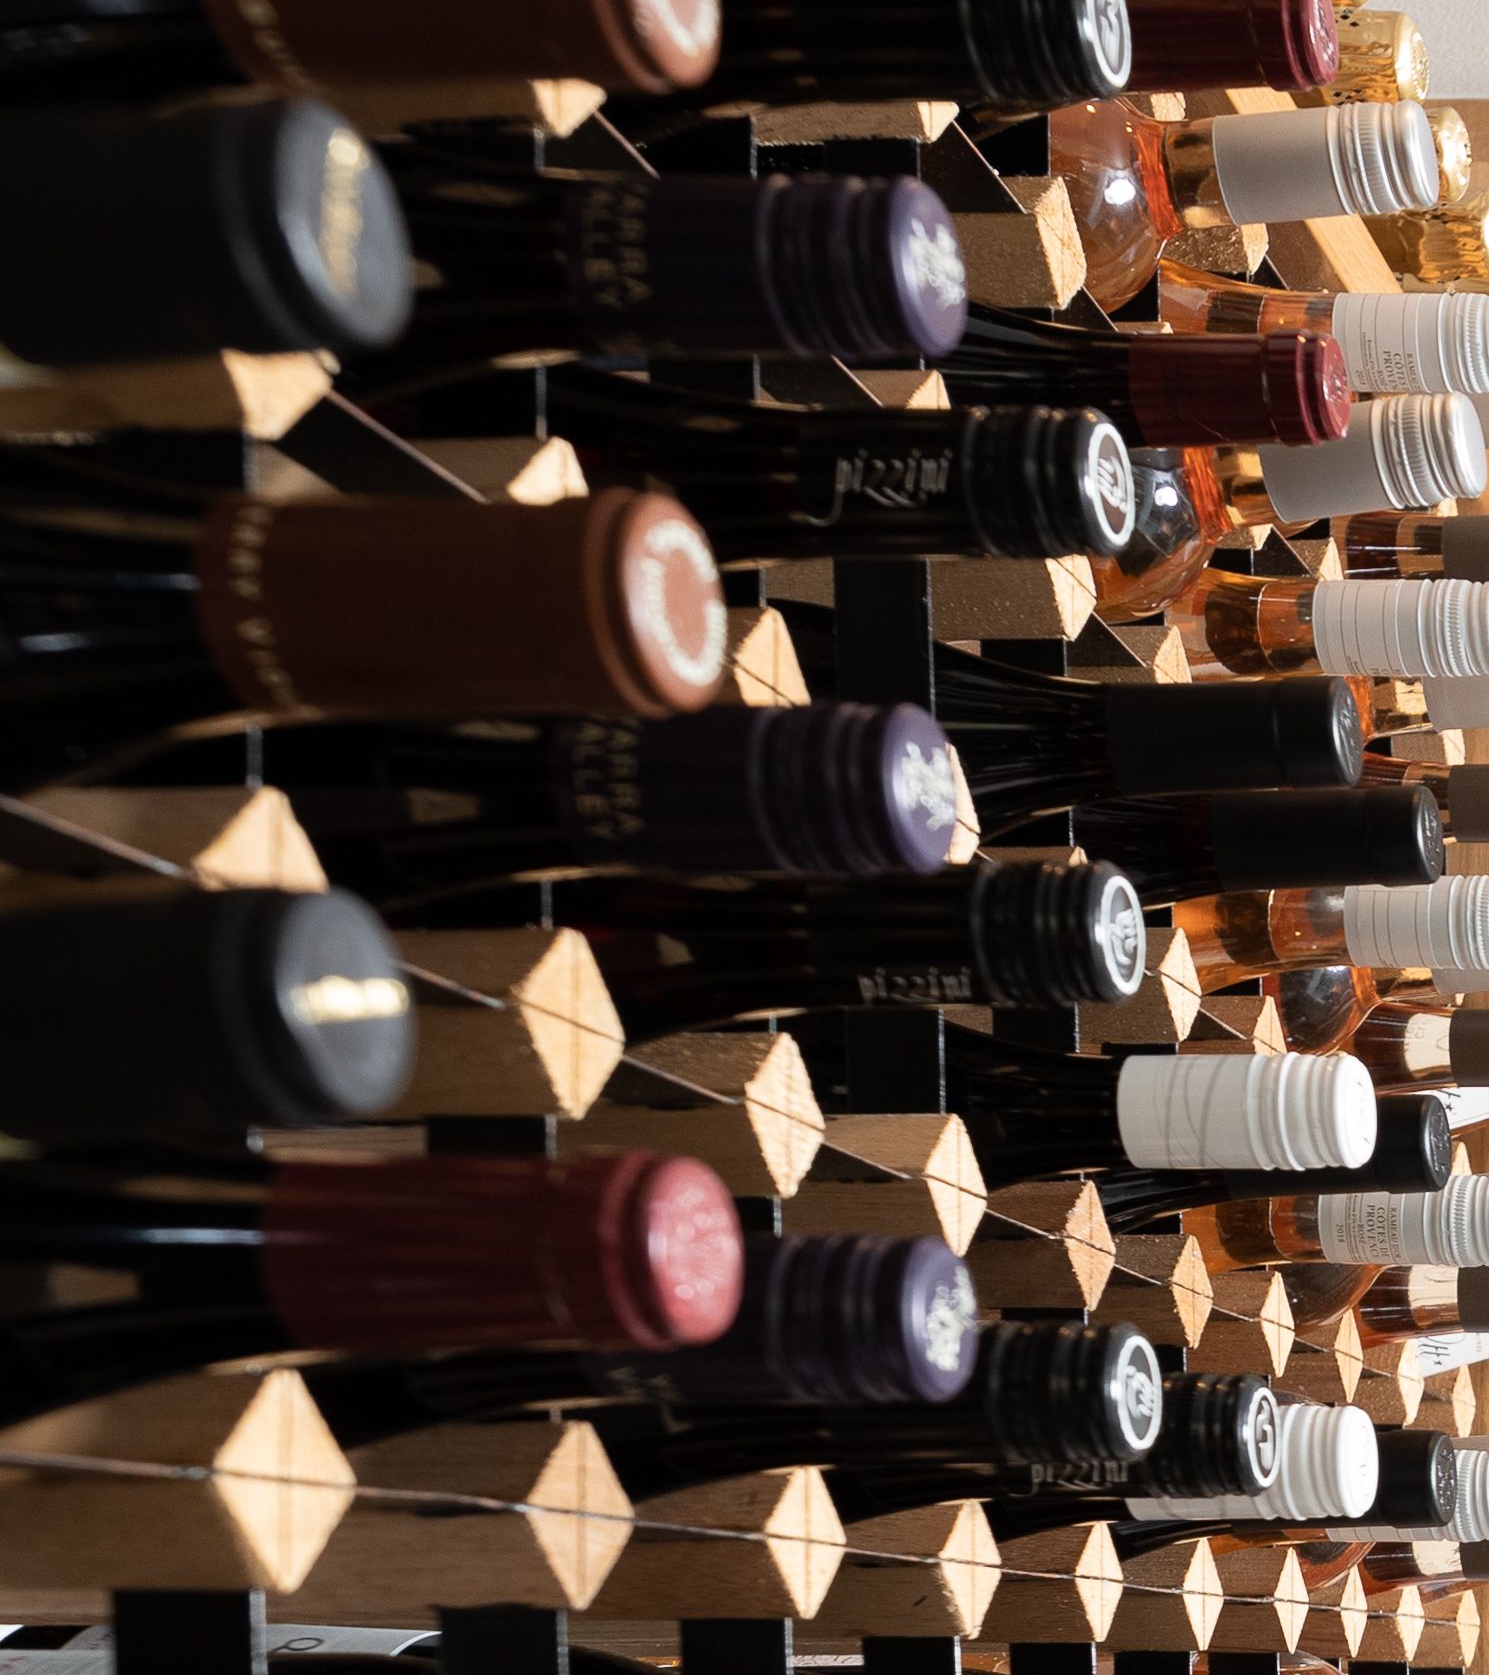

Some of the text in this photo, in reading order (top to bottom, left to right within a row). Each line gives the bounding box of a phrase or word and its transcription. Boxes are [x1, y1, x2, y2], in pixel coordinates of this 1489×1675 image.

[582, 186, 625, 308] ALLEY
[804, 448, 954, 527] pizzini
[574, 722, 618, 839] ALLEY
[1367, 1205, 1379, 1258] PROVENCE
